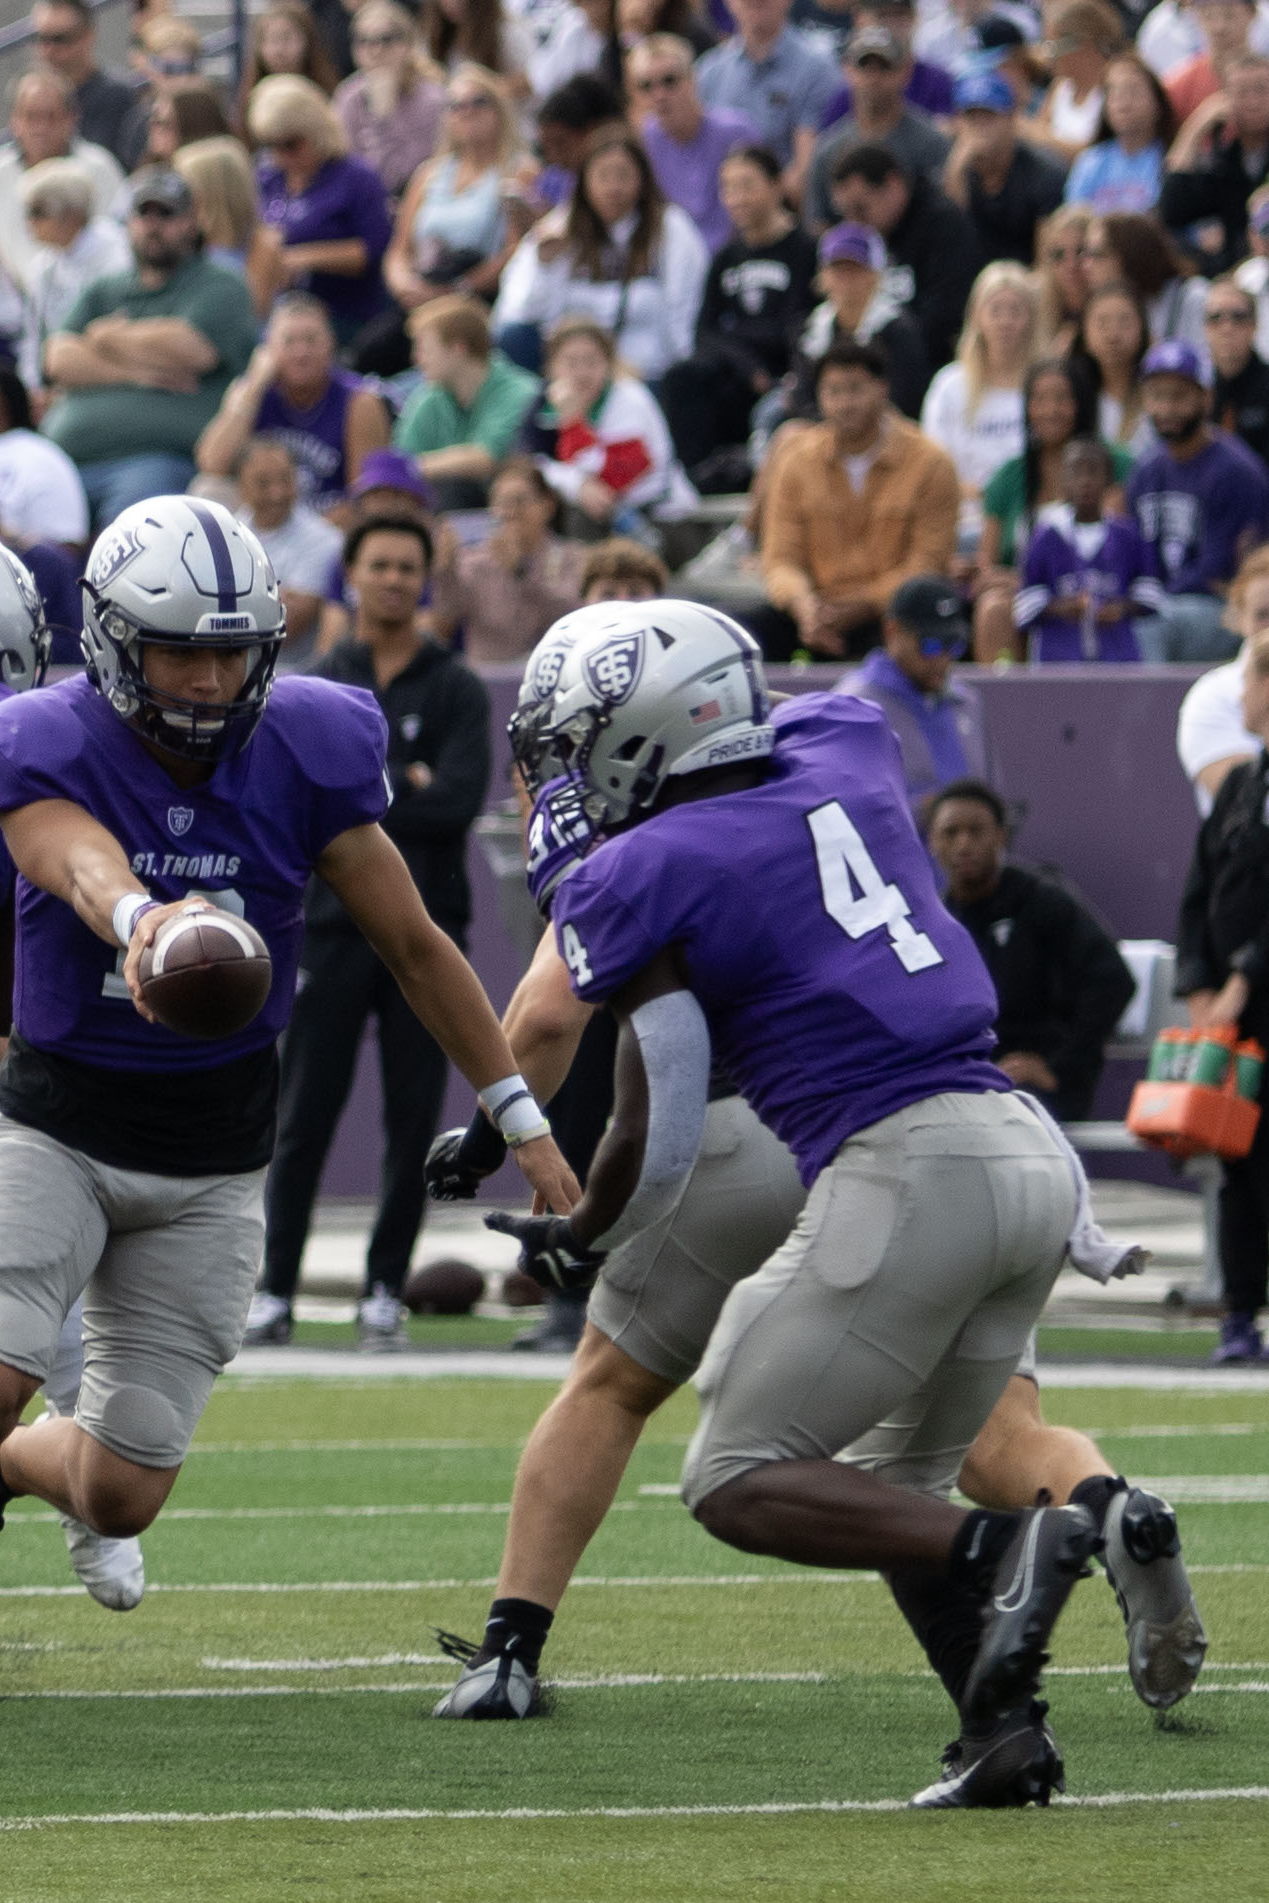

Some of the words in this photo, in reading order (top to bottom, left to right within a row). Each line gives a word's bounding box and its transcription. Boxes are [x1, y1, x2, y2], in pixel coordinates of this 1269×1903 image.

[209, 617, 250, 630] TOMMIES
[708, 736, 754, 763] PRIDE
[132, 851, 158, 877] ST.
[161, 854, 242, 879] THOMAS
[806, 801, 945, 974] 4
[562, 923, 595, 988] 4
